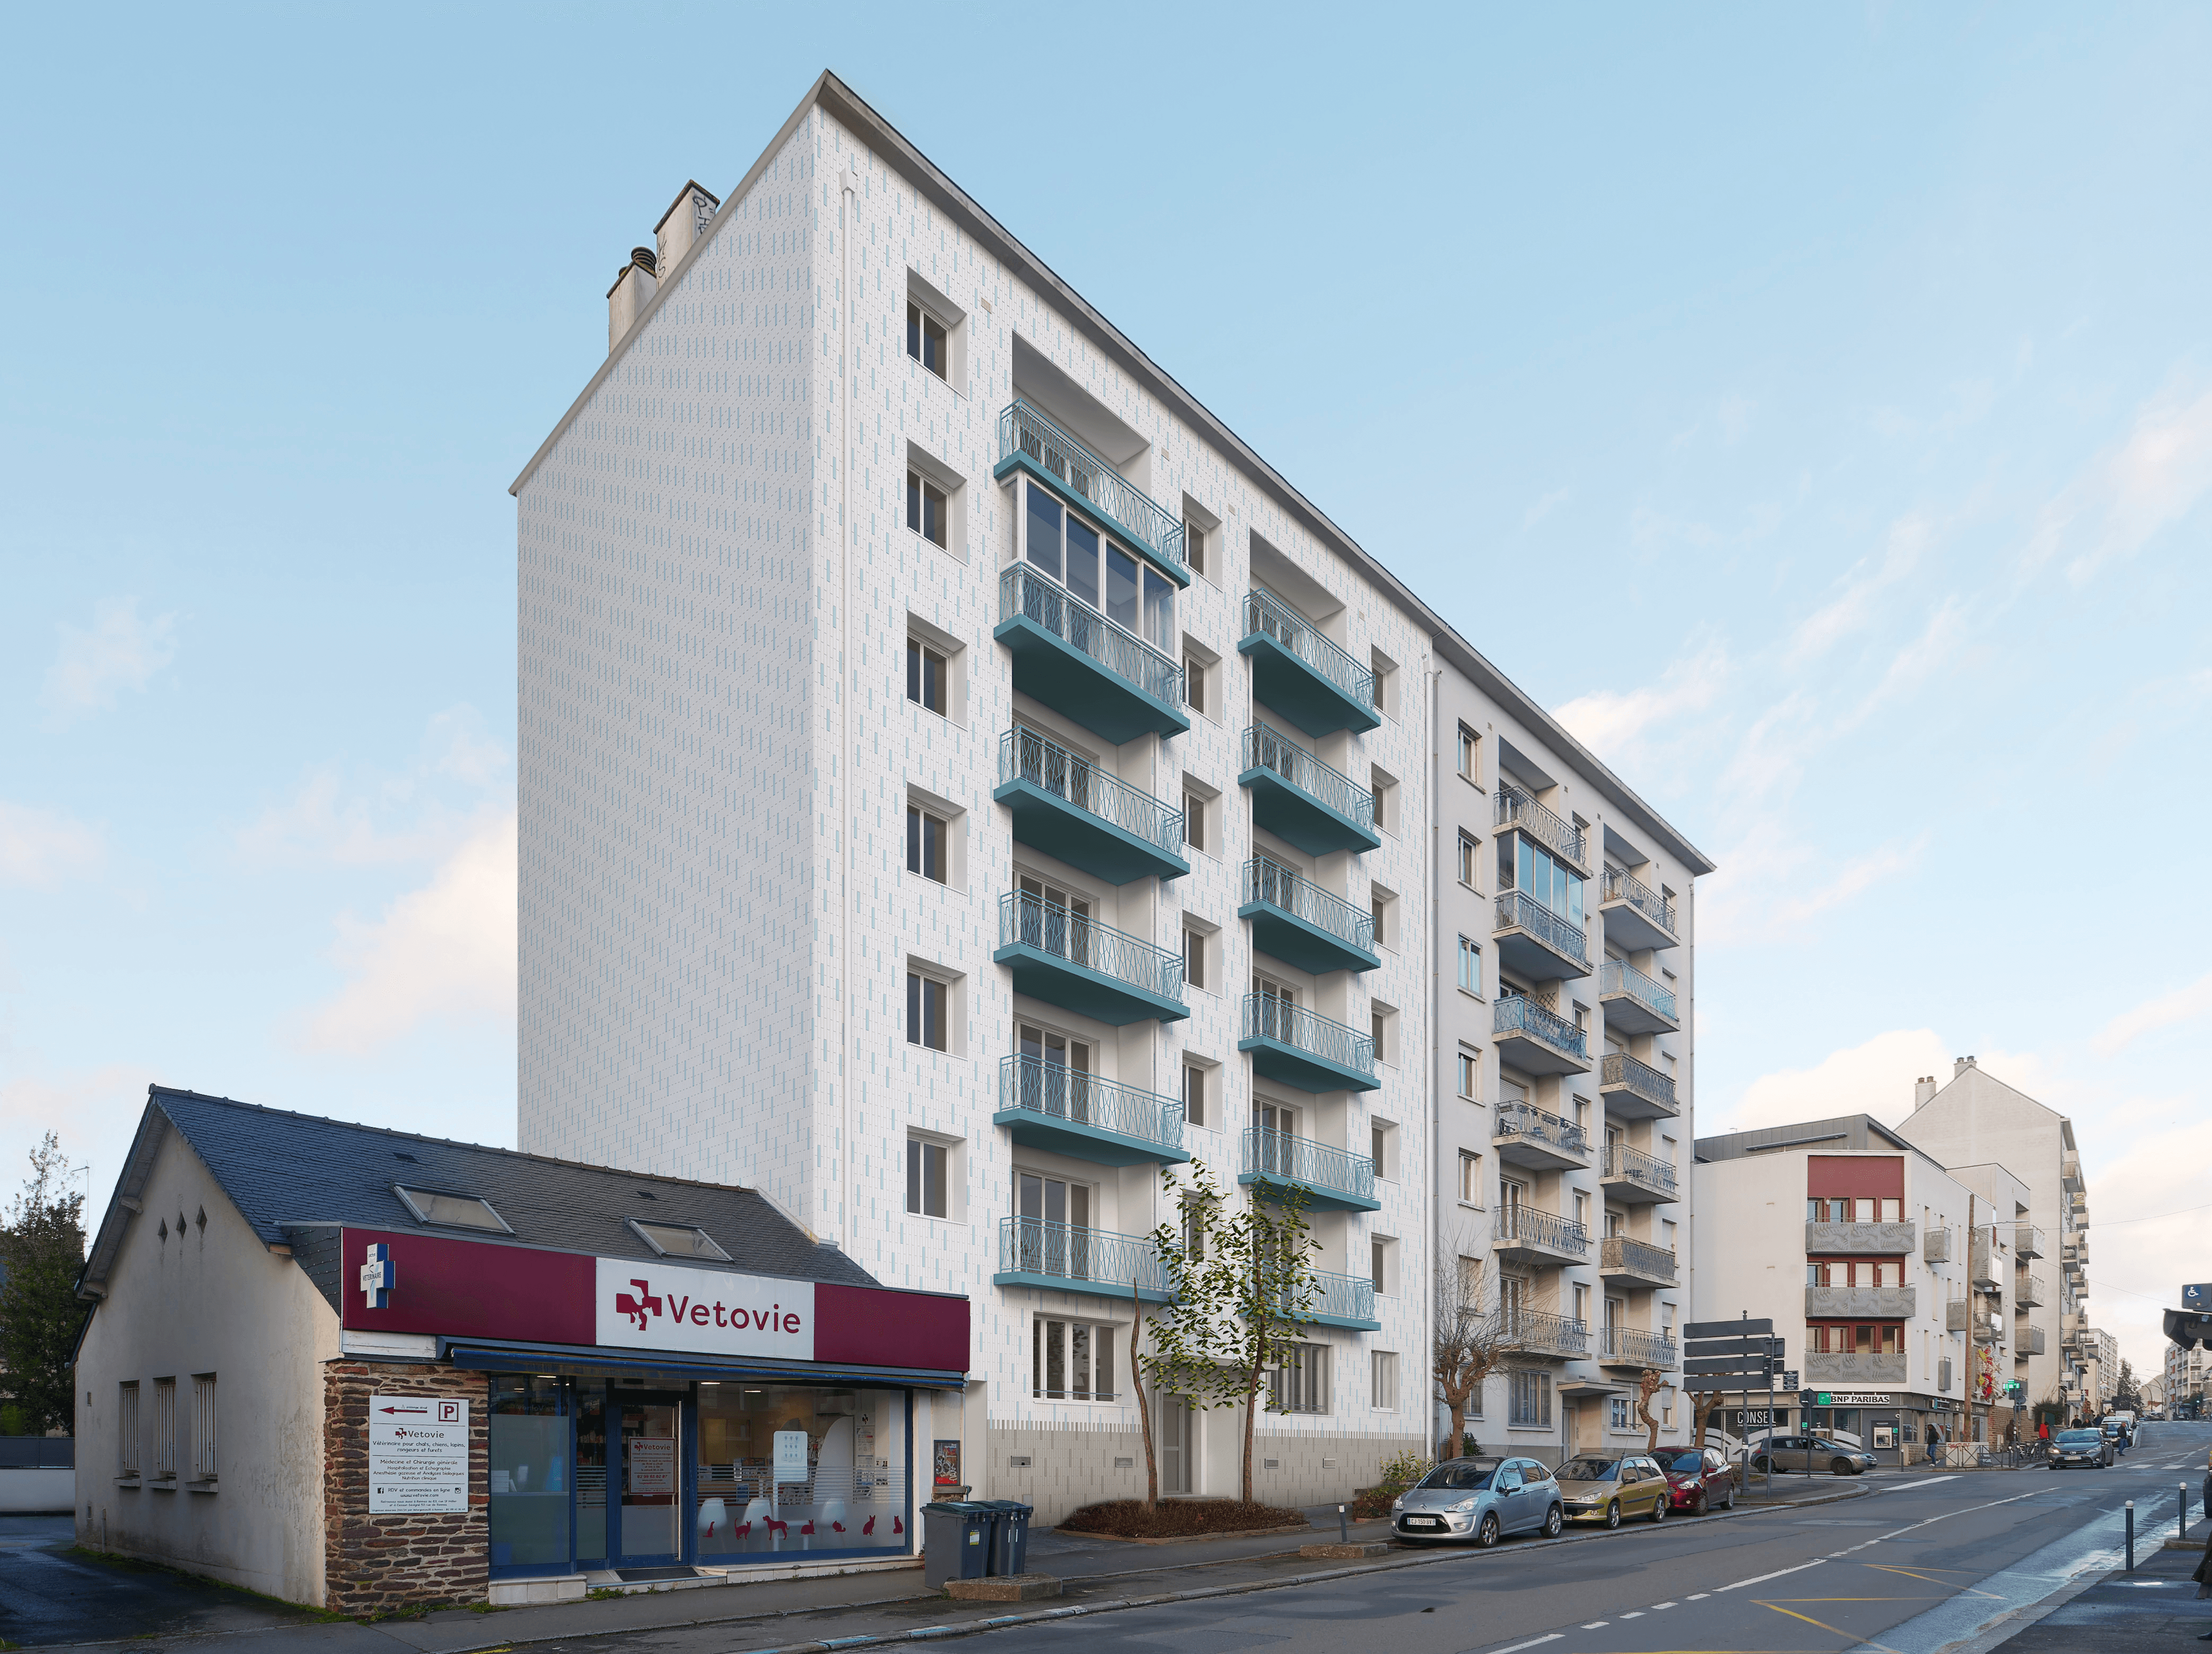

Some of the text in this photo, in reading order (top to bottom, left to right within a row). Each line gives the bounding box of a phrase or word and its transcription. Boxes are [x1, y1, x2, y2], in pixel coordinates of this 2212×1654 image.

[667, 1294, 801, 1334] Vetovie
[444, 1405, 454, 1418] P
[1737, 1411, 1777, 1424] CNSEL
